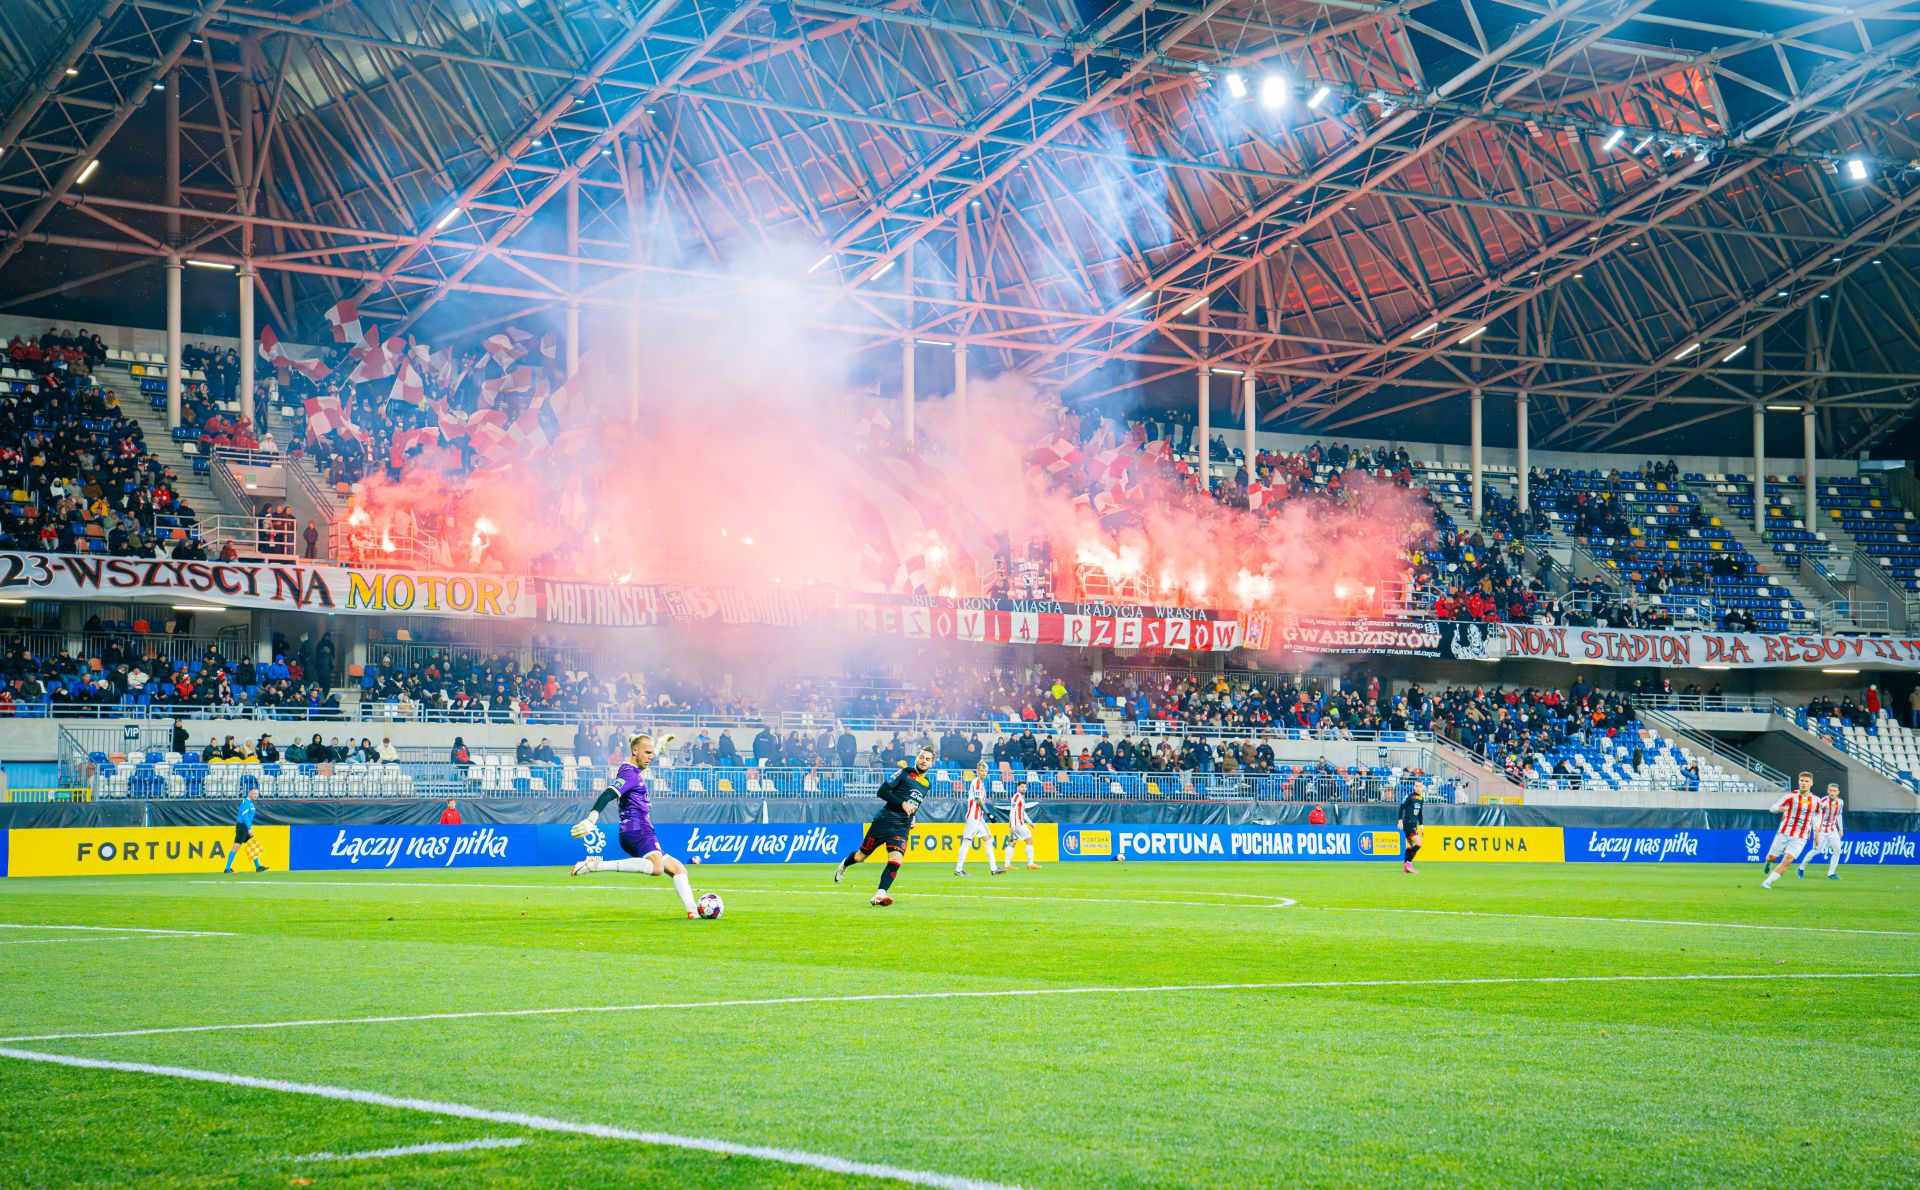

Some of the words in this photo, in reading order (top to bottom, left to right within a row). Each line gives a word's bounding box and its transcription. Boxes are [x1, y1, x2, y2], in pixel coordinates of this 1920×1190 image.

[269, 567, 336, 609] NA
[346, 572, 520, 616] MOTOR!
[947, 596, 1001, 611] STRONY
[1012, 600, 1063, 614] MIASTA
[1076, 602, 1144, 618] TRADYCJA
[1155, 607, 1207, 620] WRASTA
[1507, 626, 1569, 657] NOWY
[1585, 631, 1691, 664] STADION
[1704, 635, 1751, 663] DLA
[124, 727, 139, 737] VIP
[1378, 748, 1388, 756] VIP
[78, 841, 225, 861] FORTUNA
[331, 830, 399, 867] Łączy
[406, 835, 448, 858] nas
[446, 828, 509, 867] piłka
[687, 827, 749, 862] Łączy
[754, 832, 787, 855] nas
[785, 827, 839, 862] piłka
[1119, 833, 1225, 854] FORTUNA
[1231, 832, 1294, 855] PUCHAR
[1297, 832, 1350, 855] POLSKI
[1443, 837, 1528, 851] FORTUNA
[1588, 831, 1630, 861] Łączy
[1634, 837, 1660, 855] nas
[1660, 832, 1698, 861] piłka
[1854, 841, 1880, 857] nas
[1879, 835, 1915, 863] piłka
